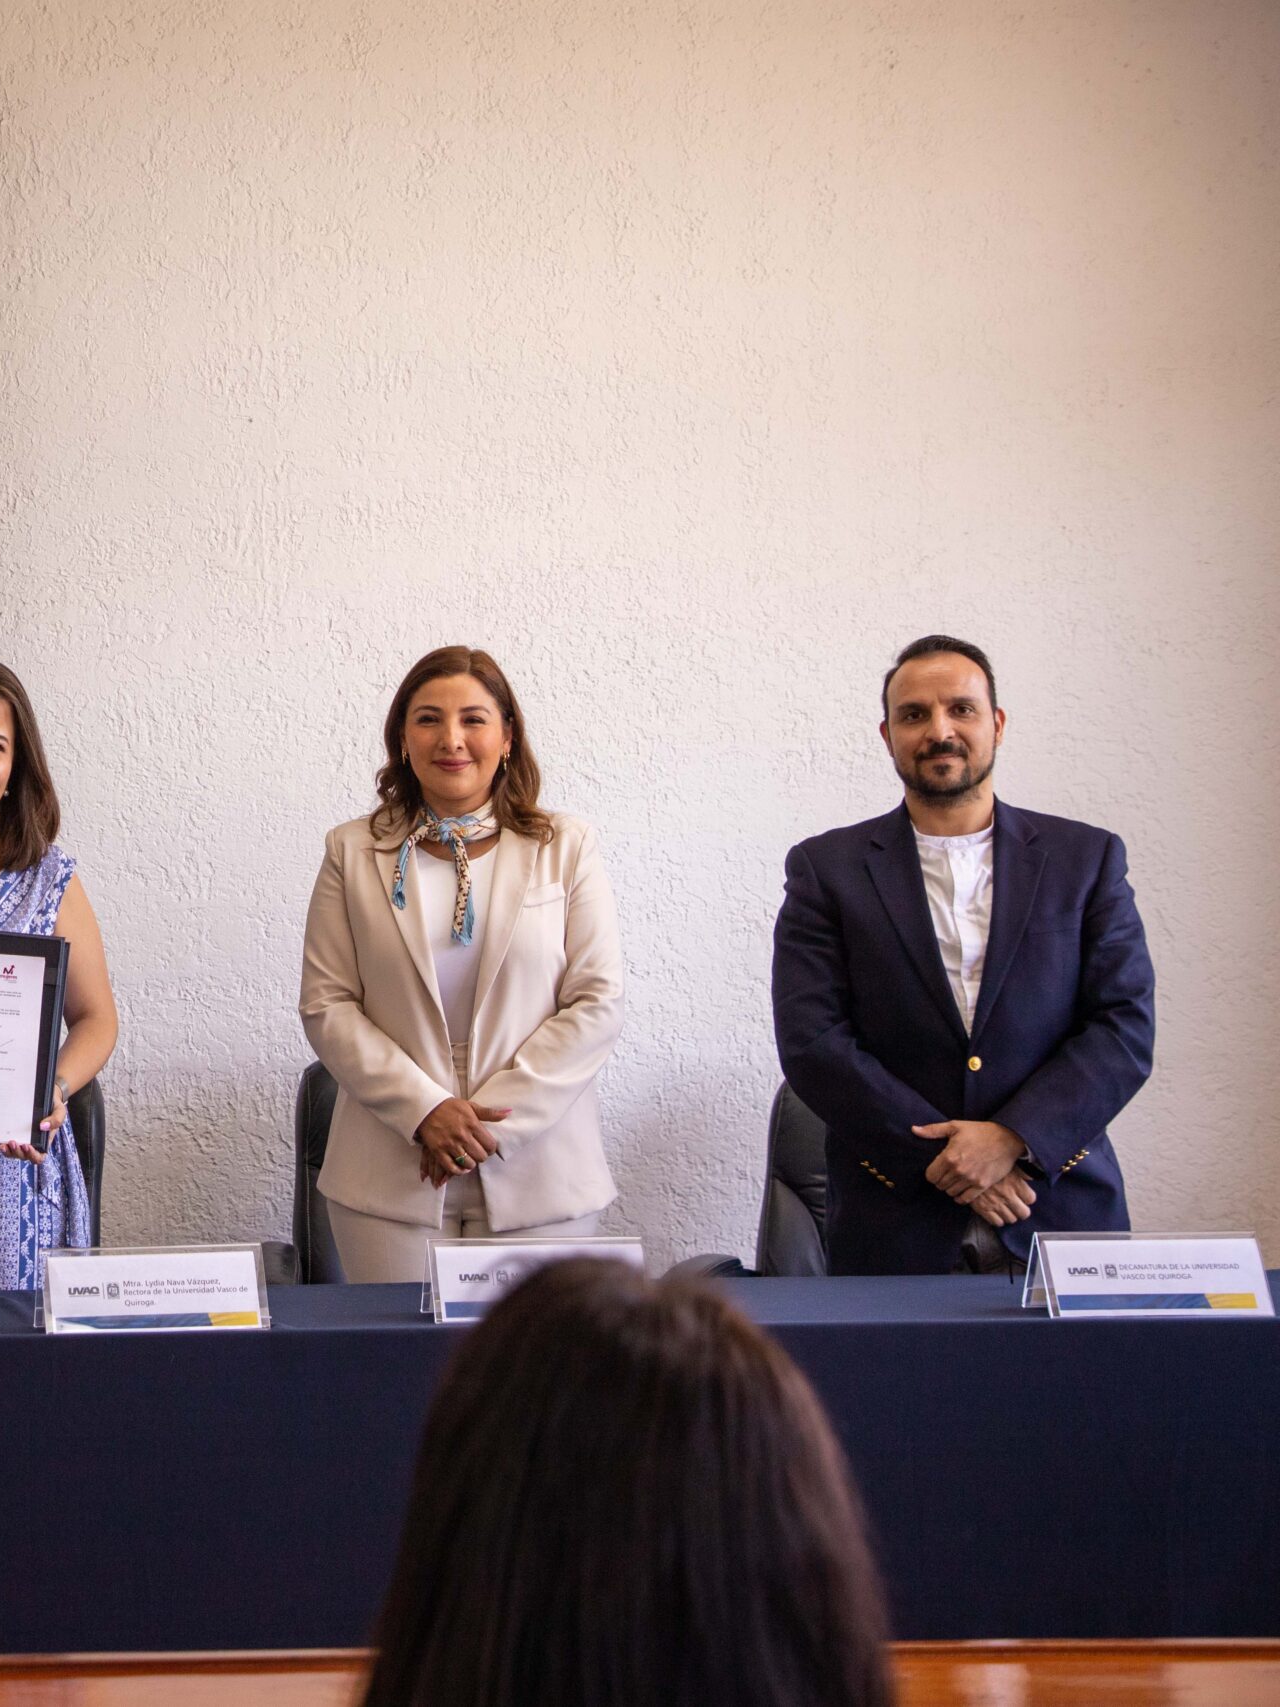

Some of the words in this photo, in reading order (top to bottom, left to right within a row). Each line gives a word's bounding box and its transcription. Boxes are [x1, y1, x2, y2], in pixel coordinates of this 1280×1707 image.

[1067, 1266, 1098, 1275] UVAQ
[1119, 1263, 1167, 1271] DECANATURA
[1192, 1262, 1239, 1270] UNIVERSIDAD
[459, 1273, 490, 1281] UVAQ
[1158, 1272, 1192, 1280] QUIROGA
[145, 1279, 165, 1288] Lydia
[187, 1277, 221, 1287] Vázquez,
[68, 1286, 100, 1295] UVAQ
[124, 1288, 151, 1296] Rectora
[153, 1287, 162, 1295] de
[173, 1286, 215, 1294] Universidad
[217, 1285, 238, 1293] Vasco
[124, 1299, 156, 1308] Quiroga.
